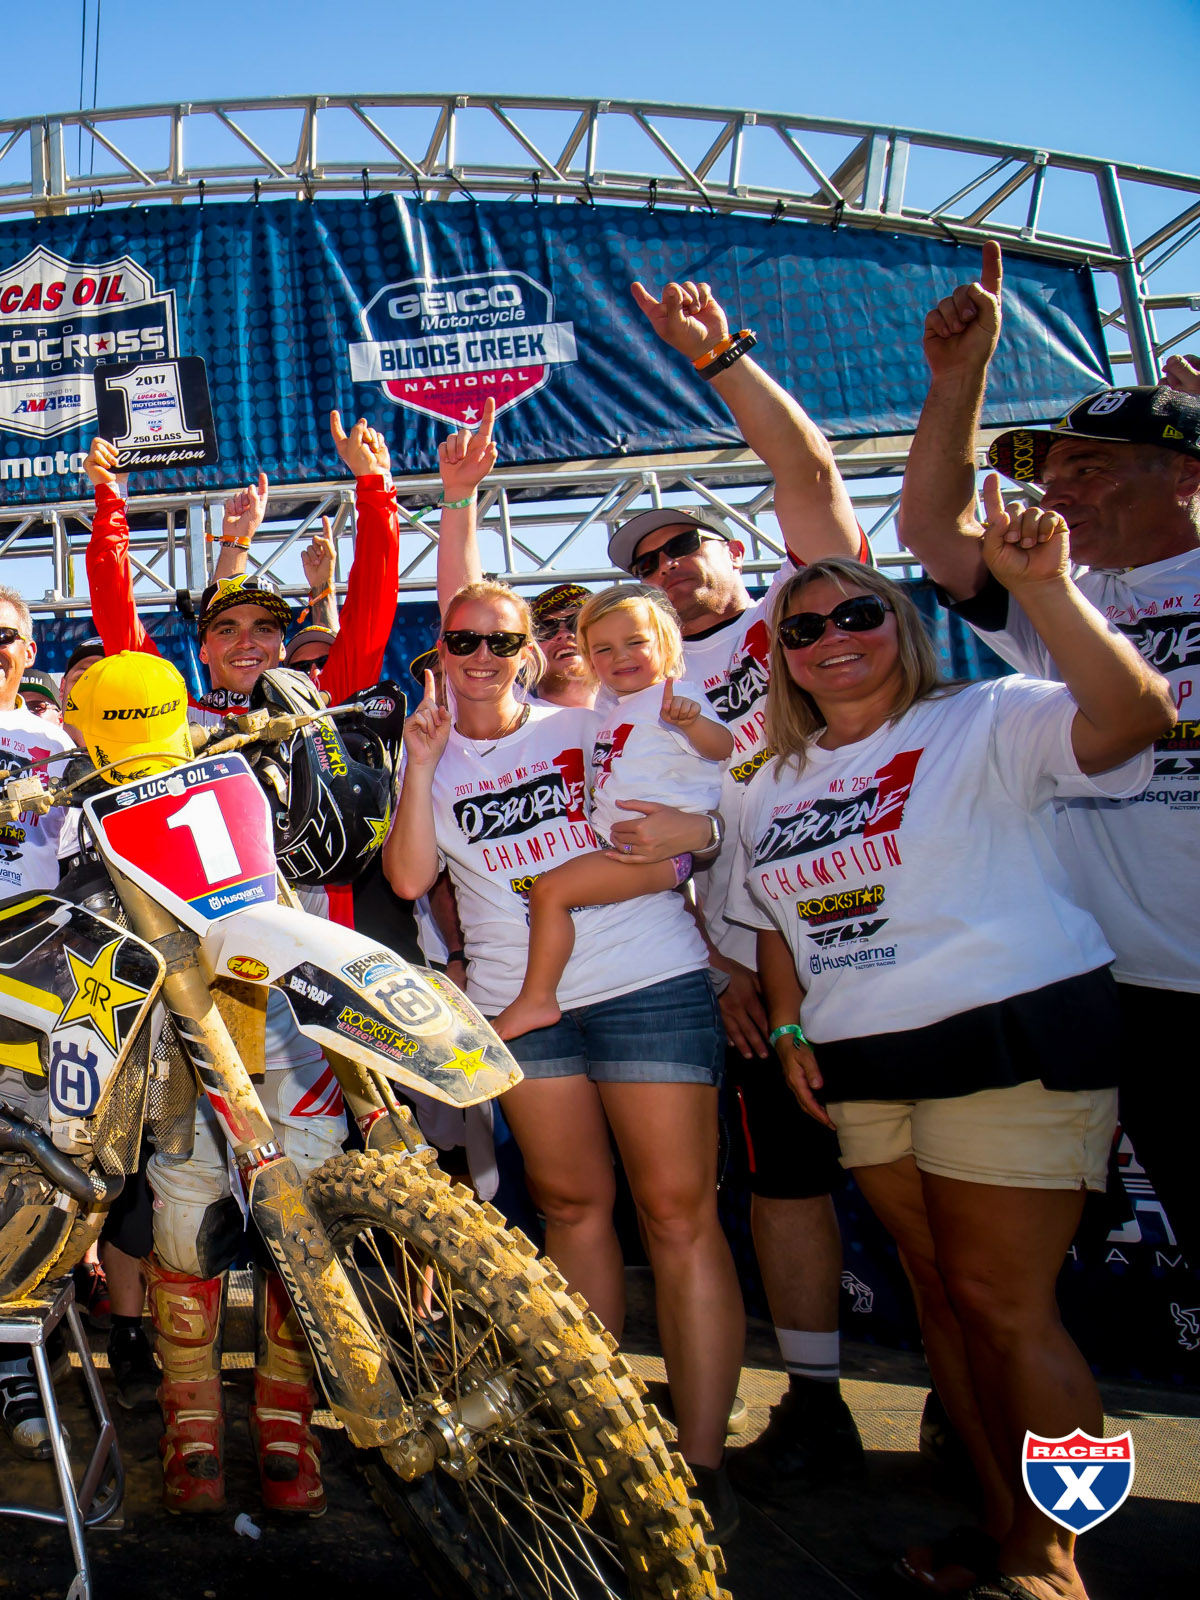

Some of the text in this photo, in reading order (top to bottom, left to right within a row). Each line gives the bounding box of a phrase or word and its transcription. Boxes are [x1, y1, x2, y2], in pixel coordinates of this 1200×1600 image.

[72, 274, 125, 305] OIL
[388, 284, 522, 320] GEICO
[420, 307, 526, 331] Motorcycle
[13, 325, 73, 338] PRO
[380, 332, 546, 372] BUDDS CREEK
[136, 375, 166, 386] 2017
[404, 372, 529, 392] NATIONAL
[26, 388, 62, 398] SANCTIONED
[12, 394, 80, 414] AMA PRO
[132, 400, 175, 408] MOTOCROSS
[134, 432, 182, 444] 250 CLASS
[116, 449, 206, 468] Champion
[704, 674, 722, 689] AMA
[102, 699, 180, 720] DUNLOP
[2, 737, 10, 746] MX
[14, 741, 25, 752] 250
[187, 768, 210, 784] OIL
[455, 761, 548, 796] 2017 AMA PRO MX 250
[462, 778, 584, 838] OSBORNE
[772, 804, 792, 818] 2017
[829, 779, 844, 793] MX
[756, 784, 911, 862] OSBORNE
[166, 790, 242, 885] 1
[482, 824, 598, 872] CHAMPION
[762, 834, 902, 900] CHAMPION
[219, 885, 263, 906] Husqvarna
[806, 918, 890, 946] FLY
[822, 938, 870, 950] RACING
[228, 959, 268, 976] FMF
[822, 946, 896, 971] Husqvarna
[855, 960, 896, 970] FACTORY RACING
[339, 1022, 405, 1058] ENERGY DRINK
